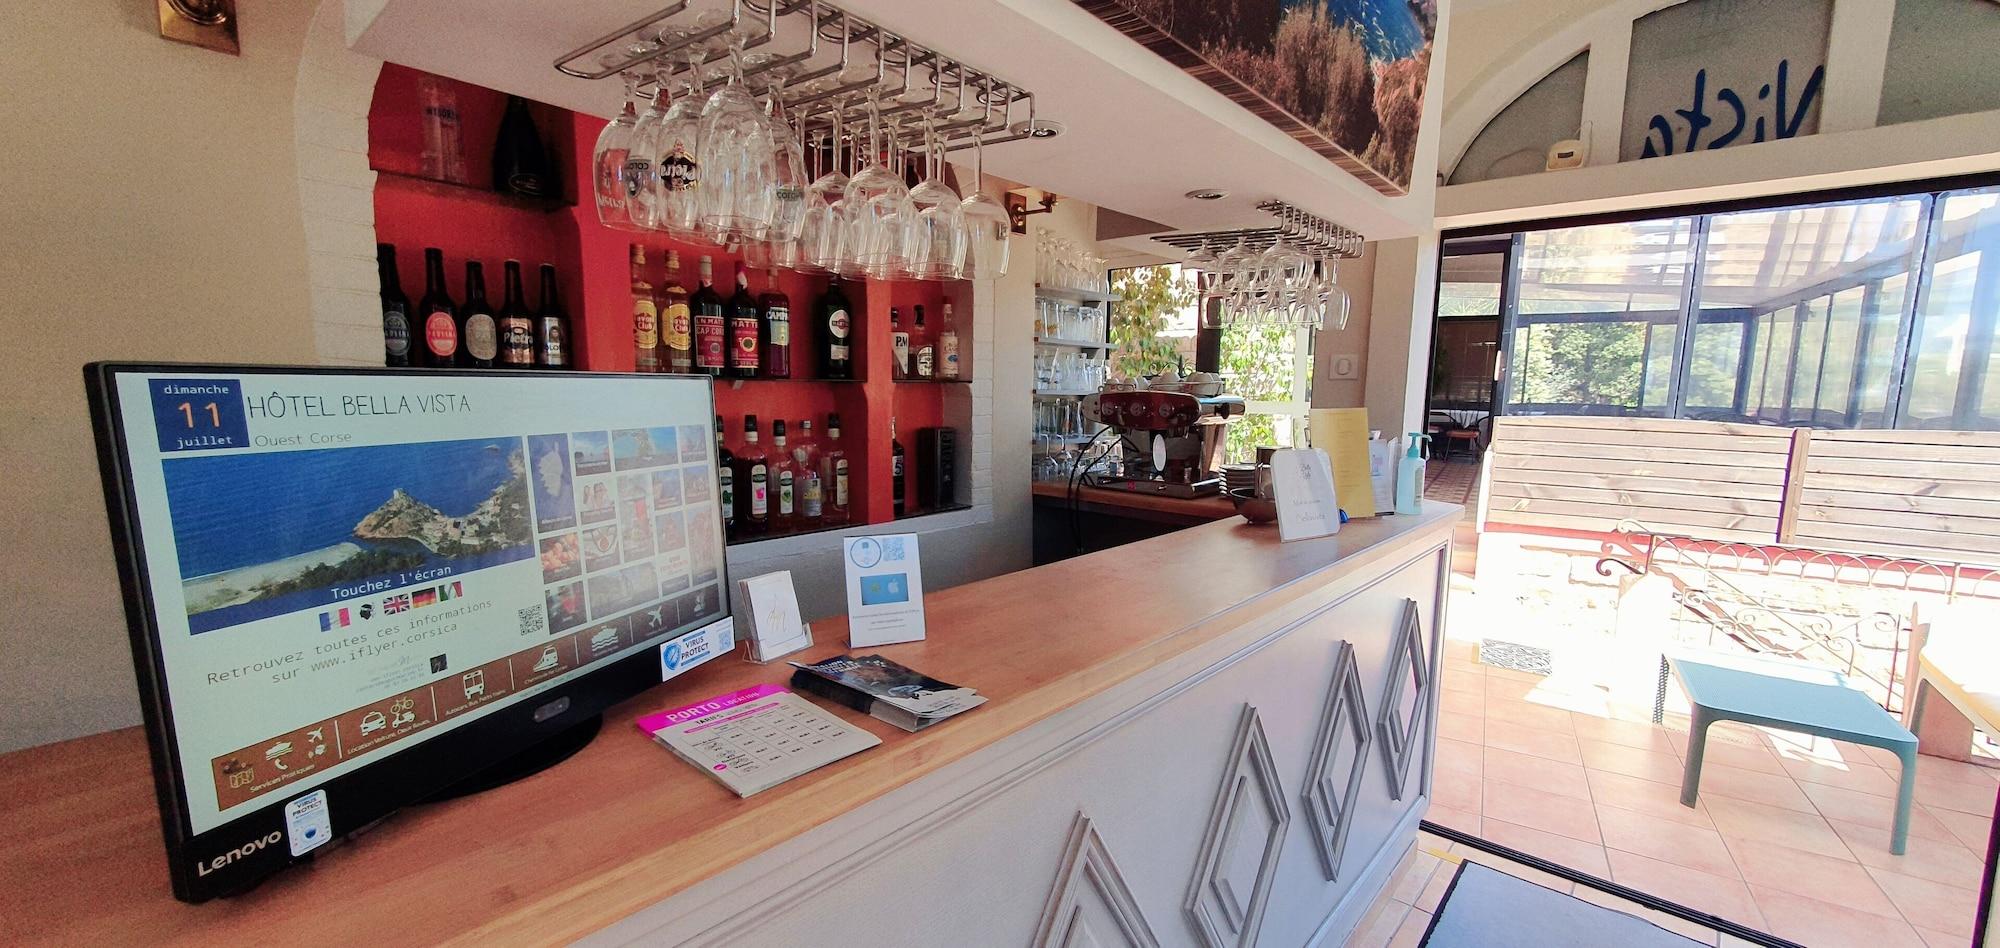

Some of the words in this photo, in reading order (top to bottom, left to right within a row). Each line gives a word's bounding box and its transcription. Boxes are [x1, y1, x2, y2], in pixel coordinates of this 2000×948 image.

[164, 385, 230, 395] dimanche
[178, 401, 221, 429] 11
[247, 391, 336, 418] HÔTEL
[342, 394, 412, 416] BELLA
[416, 394, 471, 414] VISTA
[177, 435, 233, 449] juillet
[255, 433, 303, 447] Ouest
[310, 431, 352, 444] Corse
[330, 577, 392, 600] Touchez
[400, 565, 452, 585] l'écran
[207, 651, 304, 685] Retrouvez
[315, 634, 368, 655] toutes
[377, 624, 401, 639] ces
[409, 600, 493, 629] informations
[271, 668, 301, 684] sur
[311, 623, 458, 672] www.iflyer.corsica
[681, 642, 709, 660] PROTECT
[685, 635, 704, 649] VIRUS
[665, 701, 721, 722] PORTO
[197, 830, 283, 877] Lenovo
